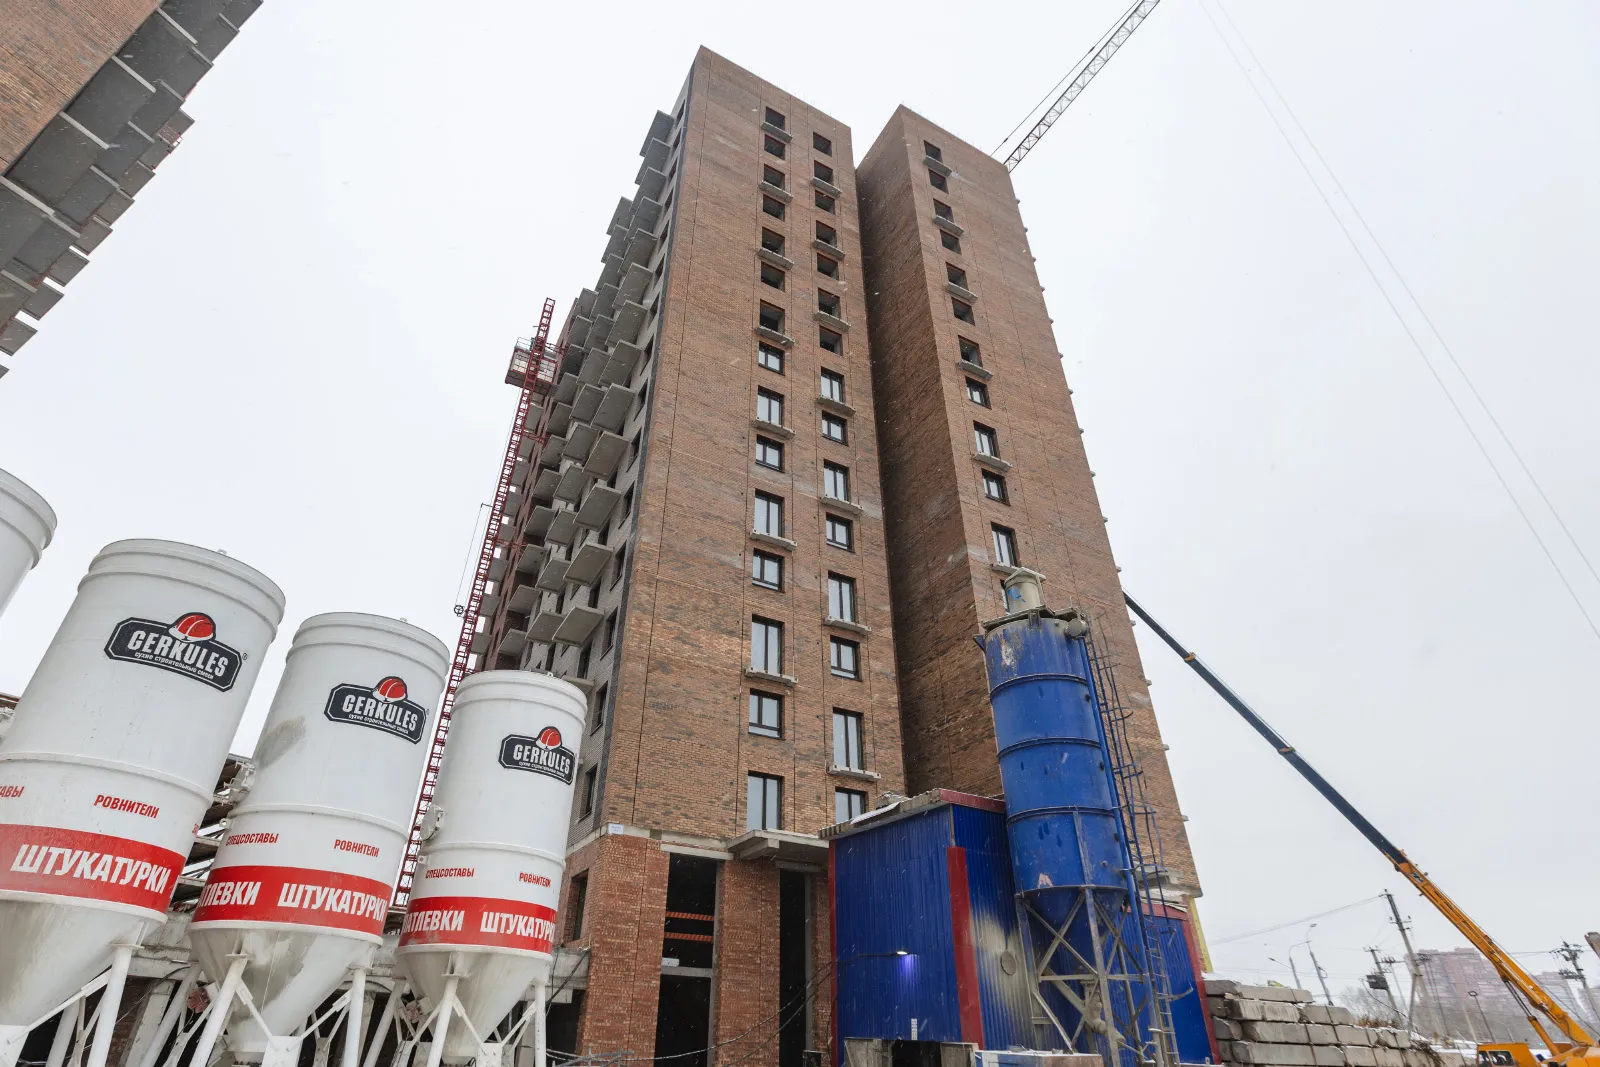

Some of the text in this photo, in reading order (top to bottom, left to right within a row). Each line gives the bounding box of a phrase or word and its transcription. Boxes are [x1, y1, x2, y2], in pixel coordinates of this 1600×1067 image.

[127, 630, 229, 677] GERKULES
[342, 694, 418, 731] GERKULES
[513, 744, 570, 775] GERKULES
[93, 794, 160, 819] РОВНИТЕЛИ
[225, 832, 380, 858] СПЕЦСОСТАВЫ РОВНИТЕЛИ
[10, 843, 171, 894] ШТУКАТУРКИ
[425, 867, 551, 888] СПЕЦСОСТАВЫ РОВНИТЕЛИ
[277, 882, 387, 923] ШТУКАТУРКИ
